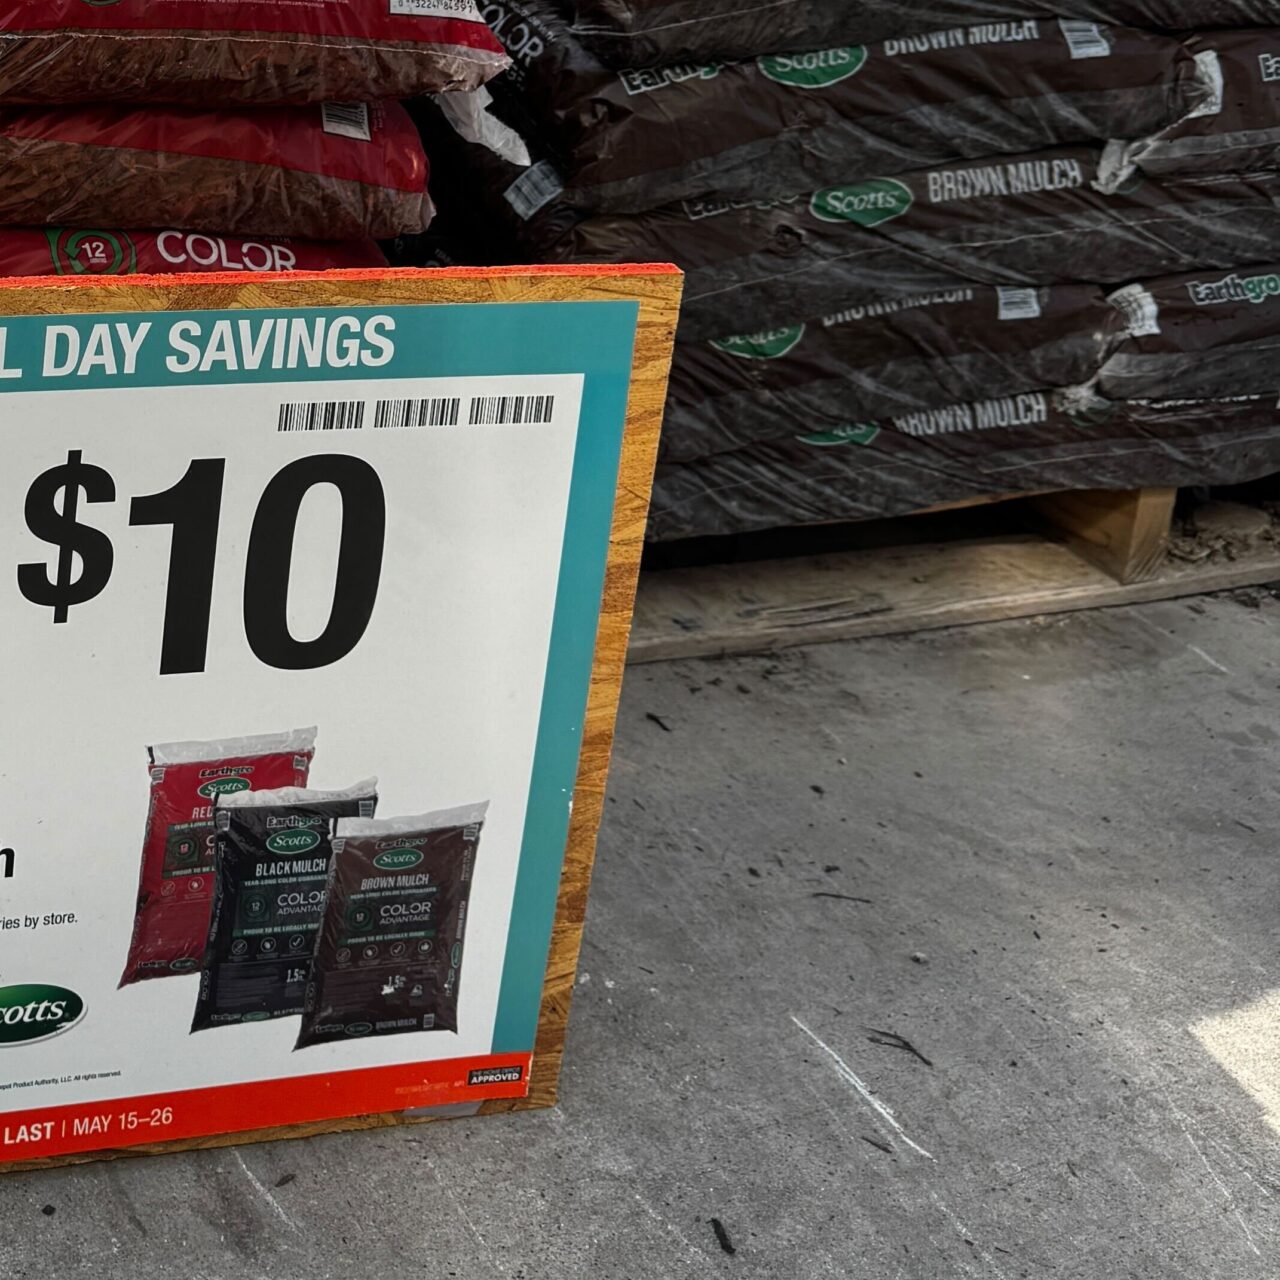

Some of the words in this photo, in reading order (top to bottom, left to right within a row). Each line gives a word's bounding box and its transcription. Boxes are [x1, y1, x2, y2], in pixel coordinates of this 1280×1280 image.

[825, 189, 900, 215] Scotts
[927, 168, 1009, 204] BROWN
[1011, 158, 1083, 191] MULCH
[81, 241, 106, 259] 12
[157, 231, 297, 272] COLOR
[42, 321, 152, 378] DAY
[166, 314, 397, 373] SAVINGS
[975, 393, 1047, 428] MULCH
[17, 449, 386, 676] $10
[205, 781, 245, 794] Scotts
[273, 834, 313, 847] Scotts
[256, 862, 290, 877] BLACK
[292, 858, 327, 874] MULCH
[380, 852, 417, 866] Scotts
[361, 876, 395, 890] BROWN
[397, 873, 430, 887] MULCH
[380, 901, 432, 917] COLOR
[23, 915, 40, 930] by
[42, 912, 79, 926] store.
[471, 1073, 520, 1084] APPROVED
[3, 1121, 55, 1143] LAST
[72, 1115, 113, 1136] MAY
